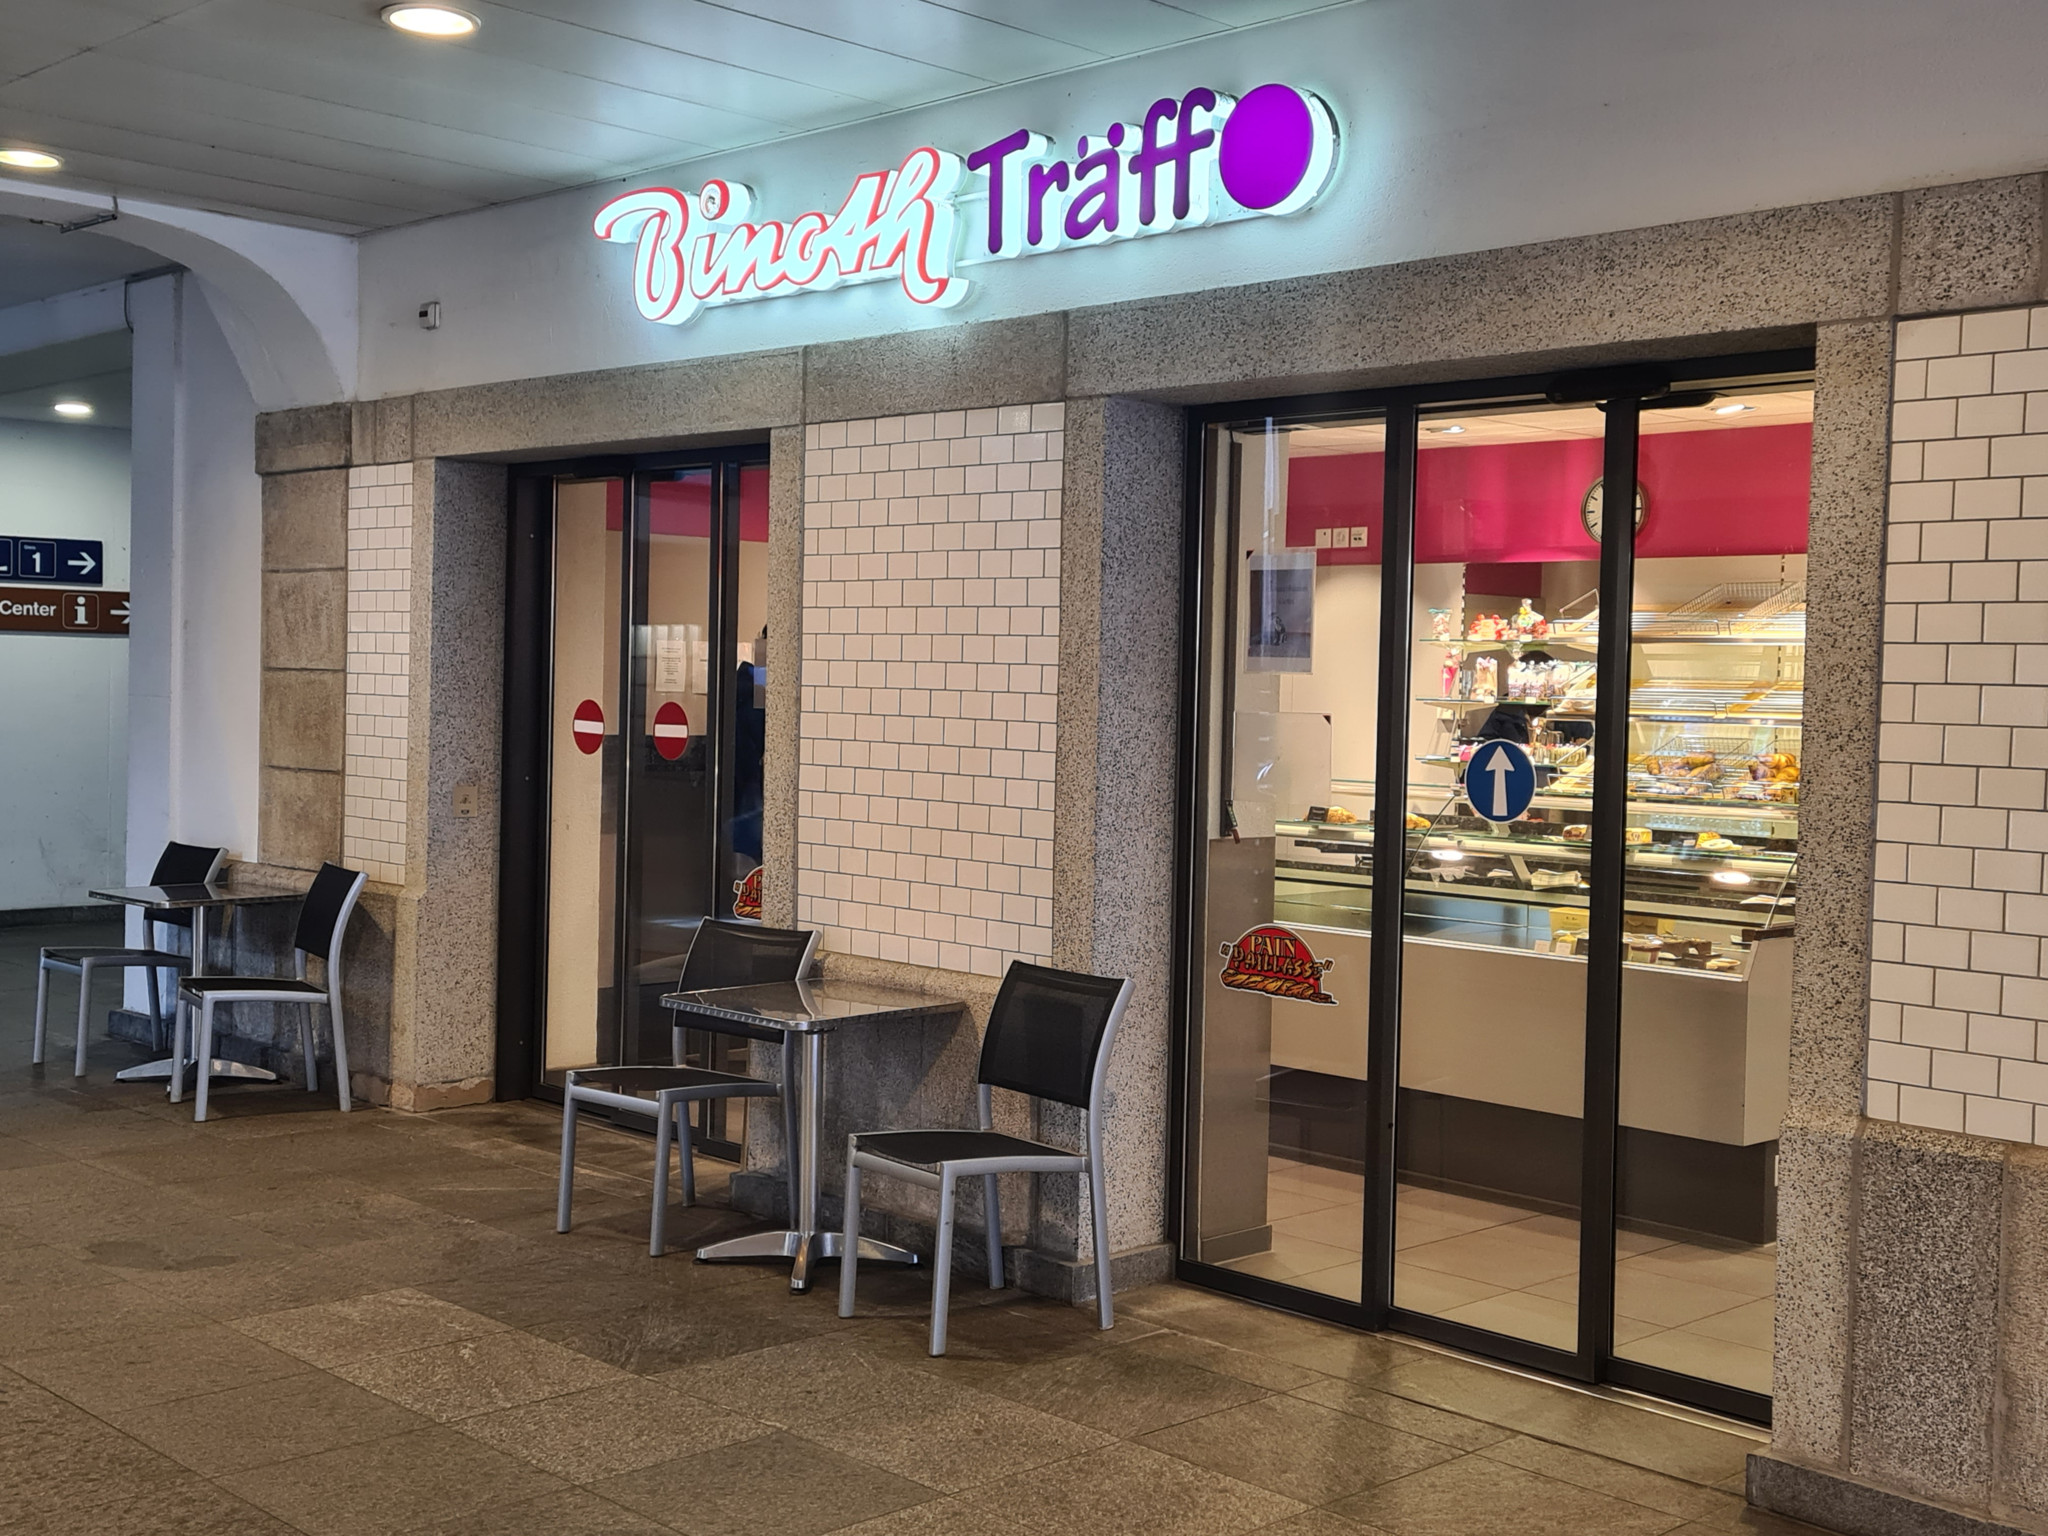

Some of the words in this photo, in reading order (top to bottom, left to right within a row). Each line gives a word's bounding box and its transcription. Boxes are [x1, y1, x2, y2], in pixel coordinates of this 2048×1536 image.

[593, 146, 950, 321] Binoth
[966, 86, 1216, 255] Träff
[32, 552, 41, 573] 1
[0, 600, 57, 616] Center
[1249, 934, 1297, 958] PAIN
